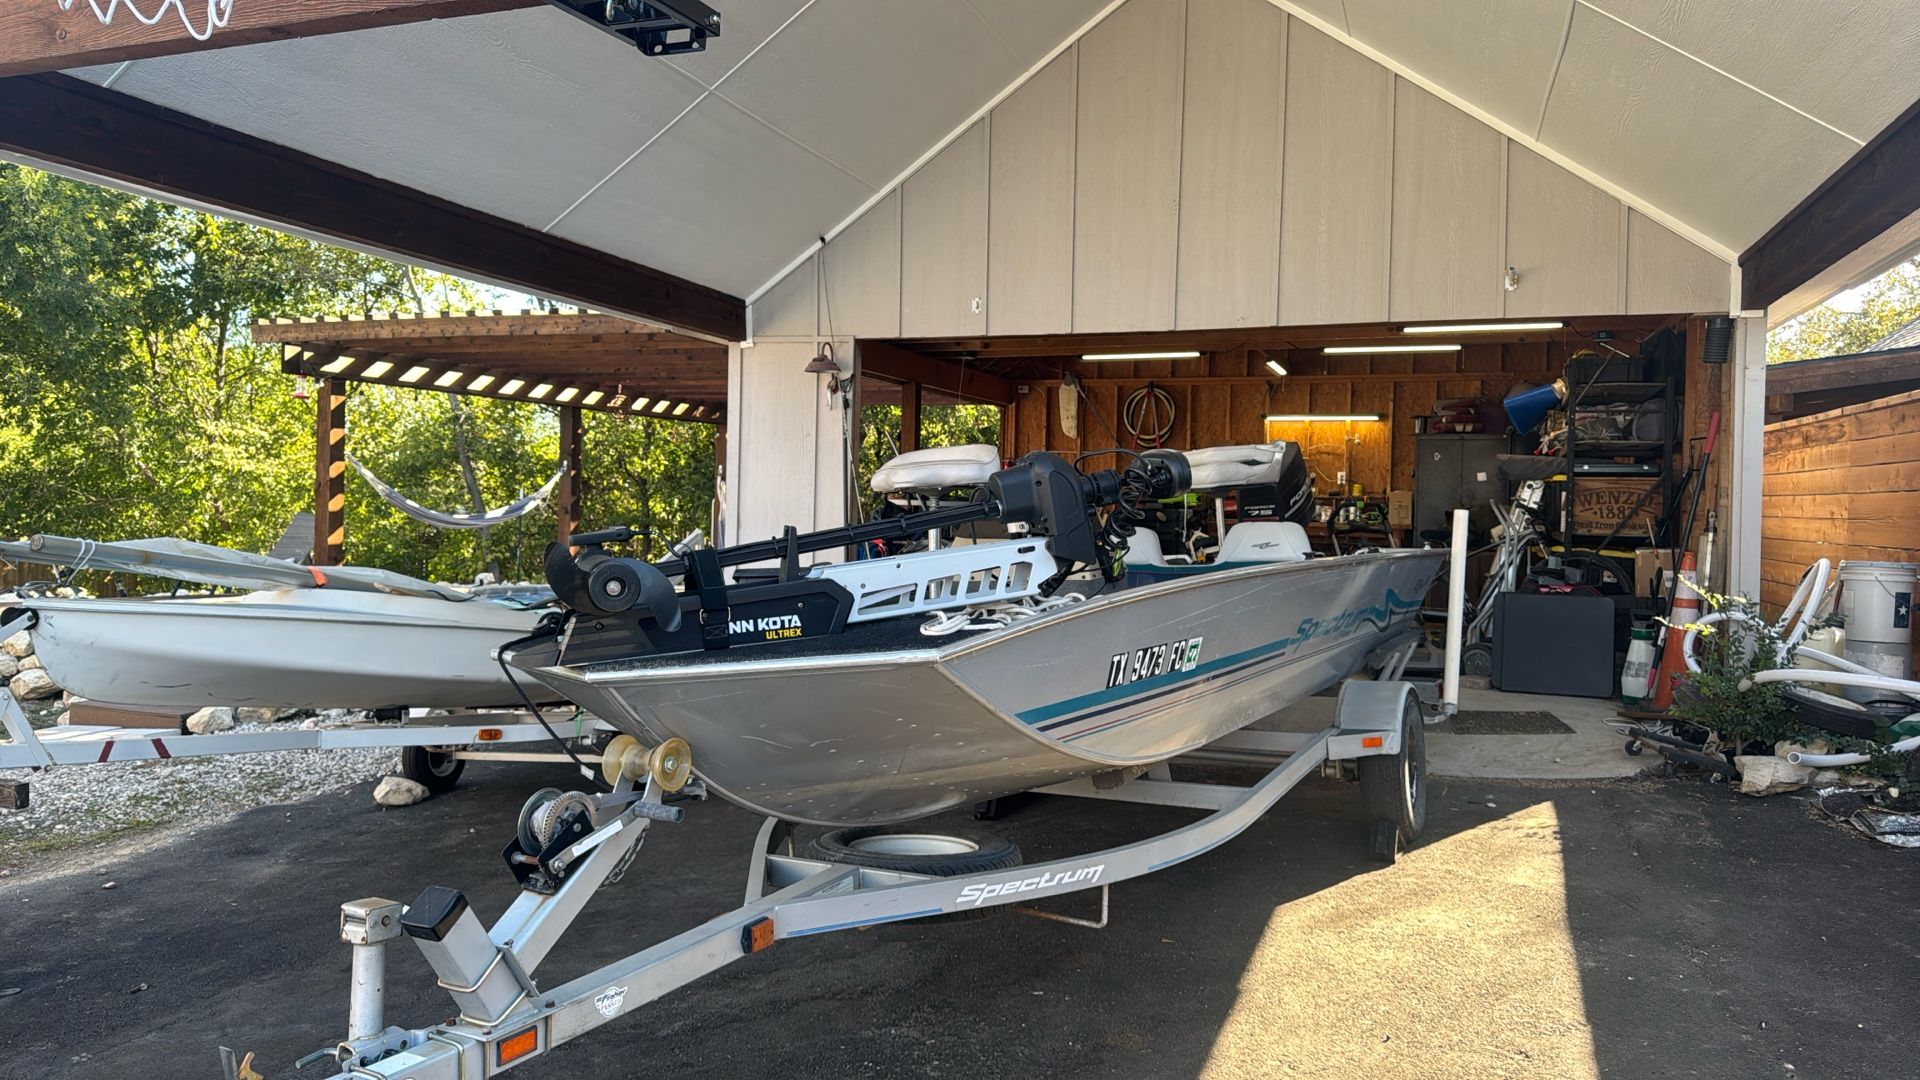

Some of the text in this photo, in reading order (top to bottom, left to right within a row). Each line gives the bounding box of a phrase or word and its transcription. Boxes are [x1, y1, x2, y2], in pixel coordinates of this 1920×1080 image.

[728, 614, 802, 635] NN KOTA
[765, 628, 802, 640] ULTREX
[1108, 653, 1129, 688] TX
[1131, 644, 1167, 682] 9473
[1167, 640, 1186, 673] FC
[956, 864, 1105, 906] Spectrum
